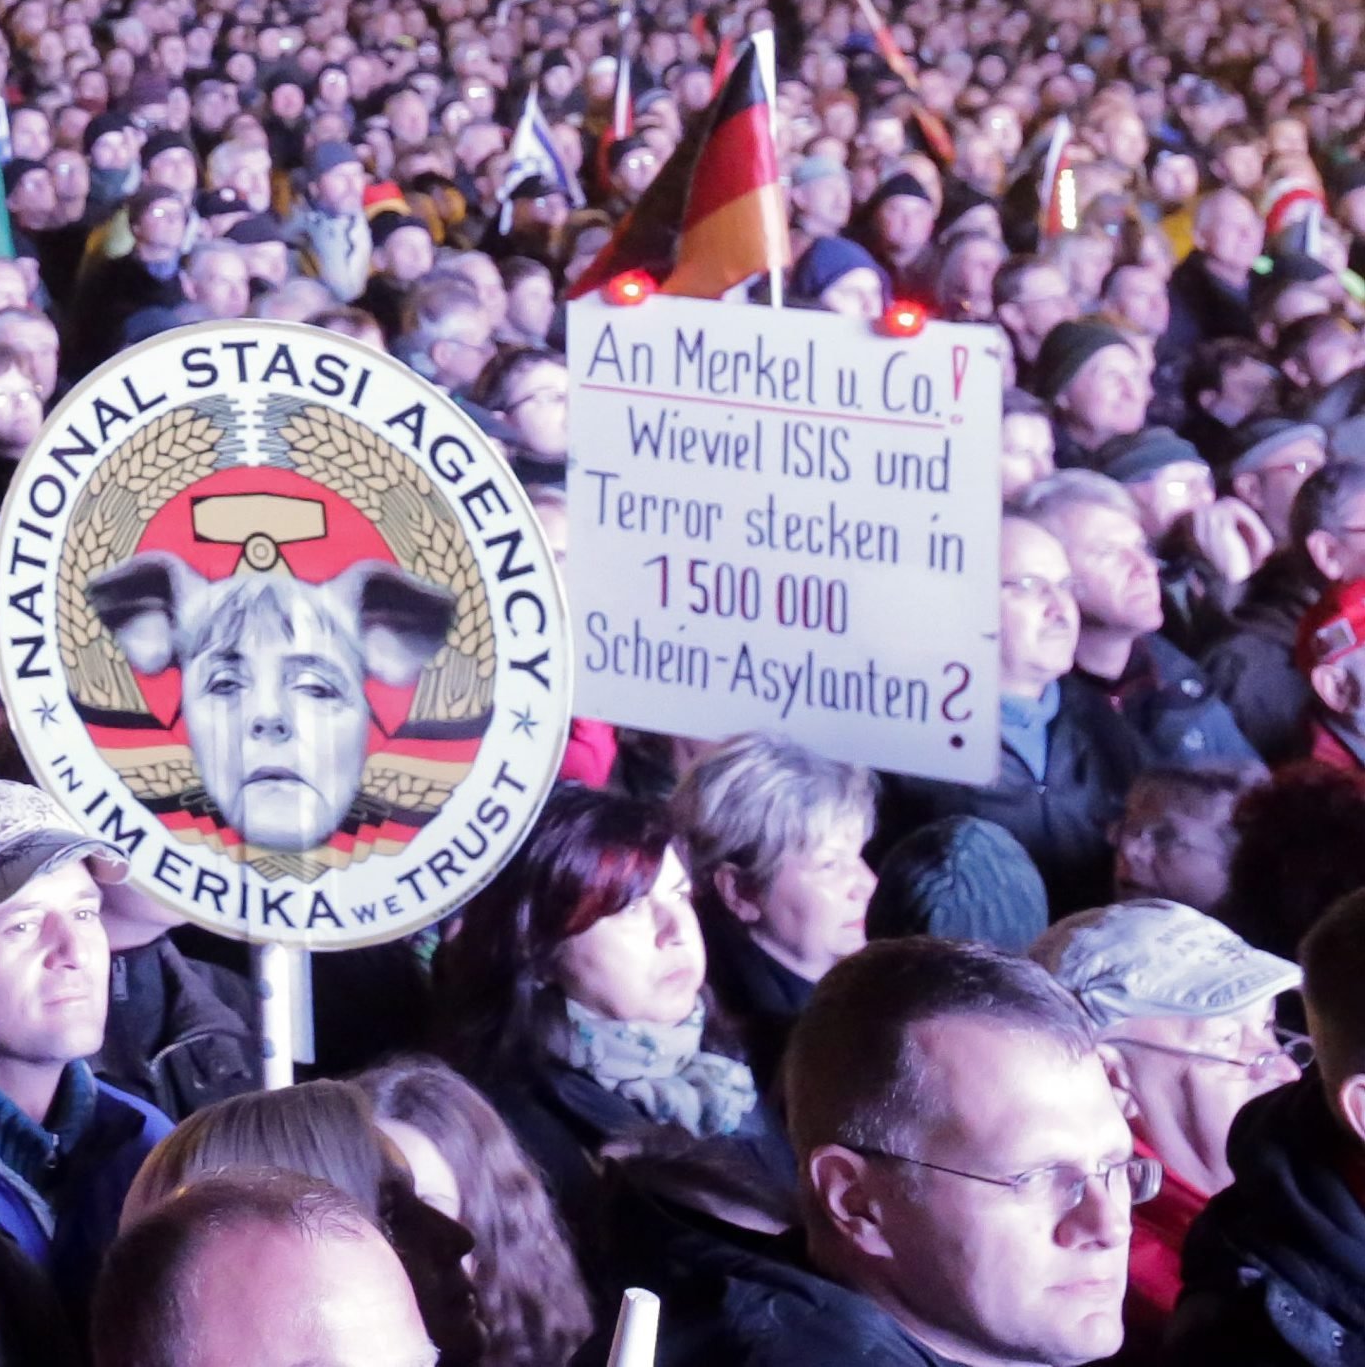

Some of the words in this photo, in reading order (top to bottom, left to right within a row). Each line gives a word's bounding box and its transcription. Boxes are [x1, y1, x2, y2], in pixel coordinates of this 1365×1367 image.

[586, 322, 654, 384] An
[673, 327, 817, 405] Merkel
[836, 367, 863, 411] u.
[627, 406, 763, 472] Wieviel
[780, 420, 852, 483] ISIS
[874, 437, 952, 493] und
[9, 375, 168, 679] NATIONAL
[180, 340, 372, 408] STASI
[384, 401, 552, 692] AGENCY
[583, 470, 722, 542] Terror
[745, 493, 900, 564] stecken
[927, 513, 965, 574] in
[50, 754, 84, 793] IN
[152, 846, 346, 930] ERIKA
[350, 895, 404, 926] WE
[397, 760, 527, 904] TRUST
